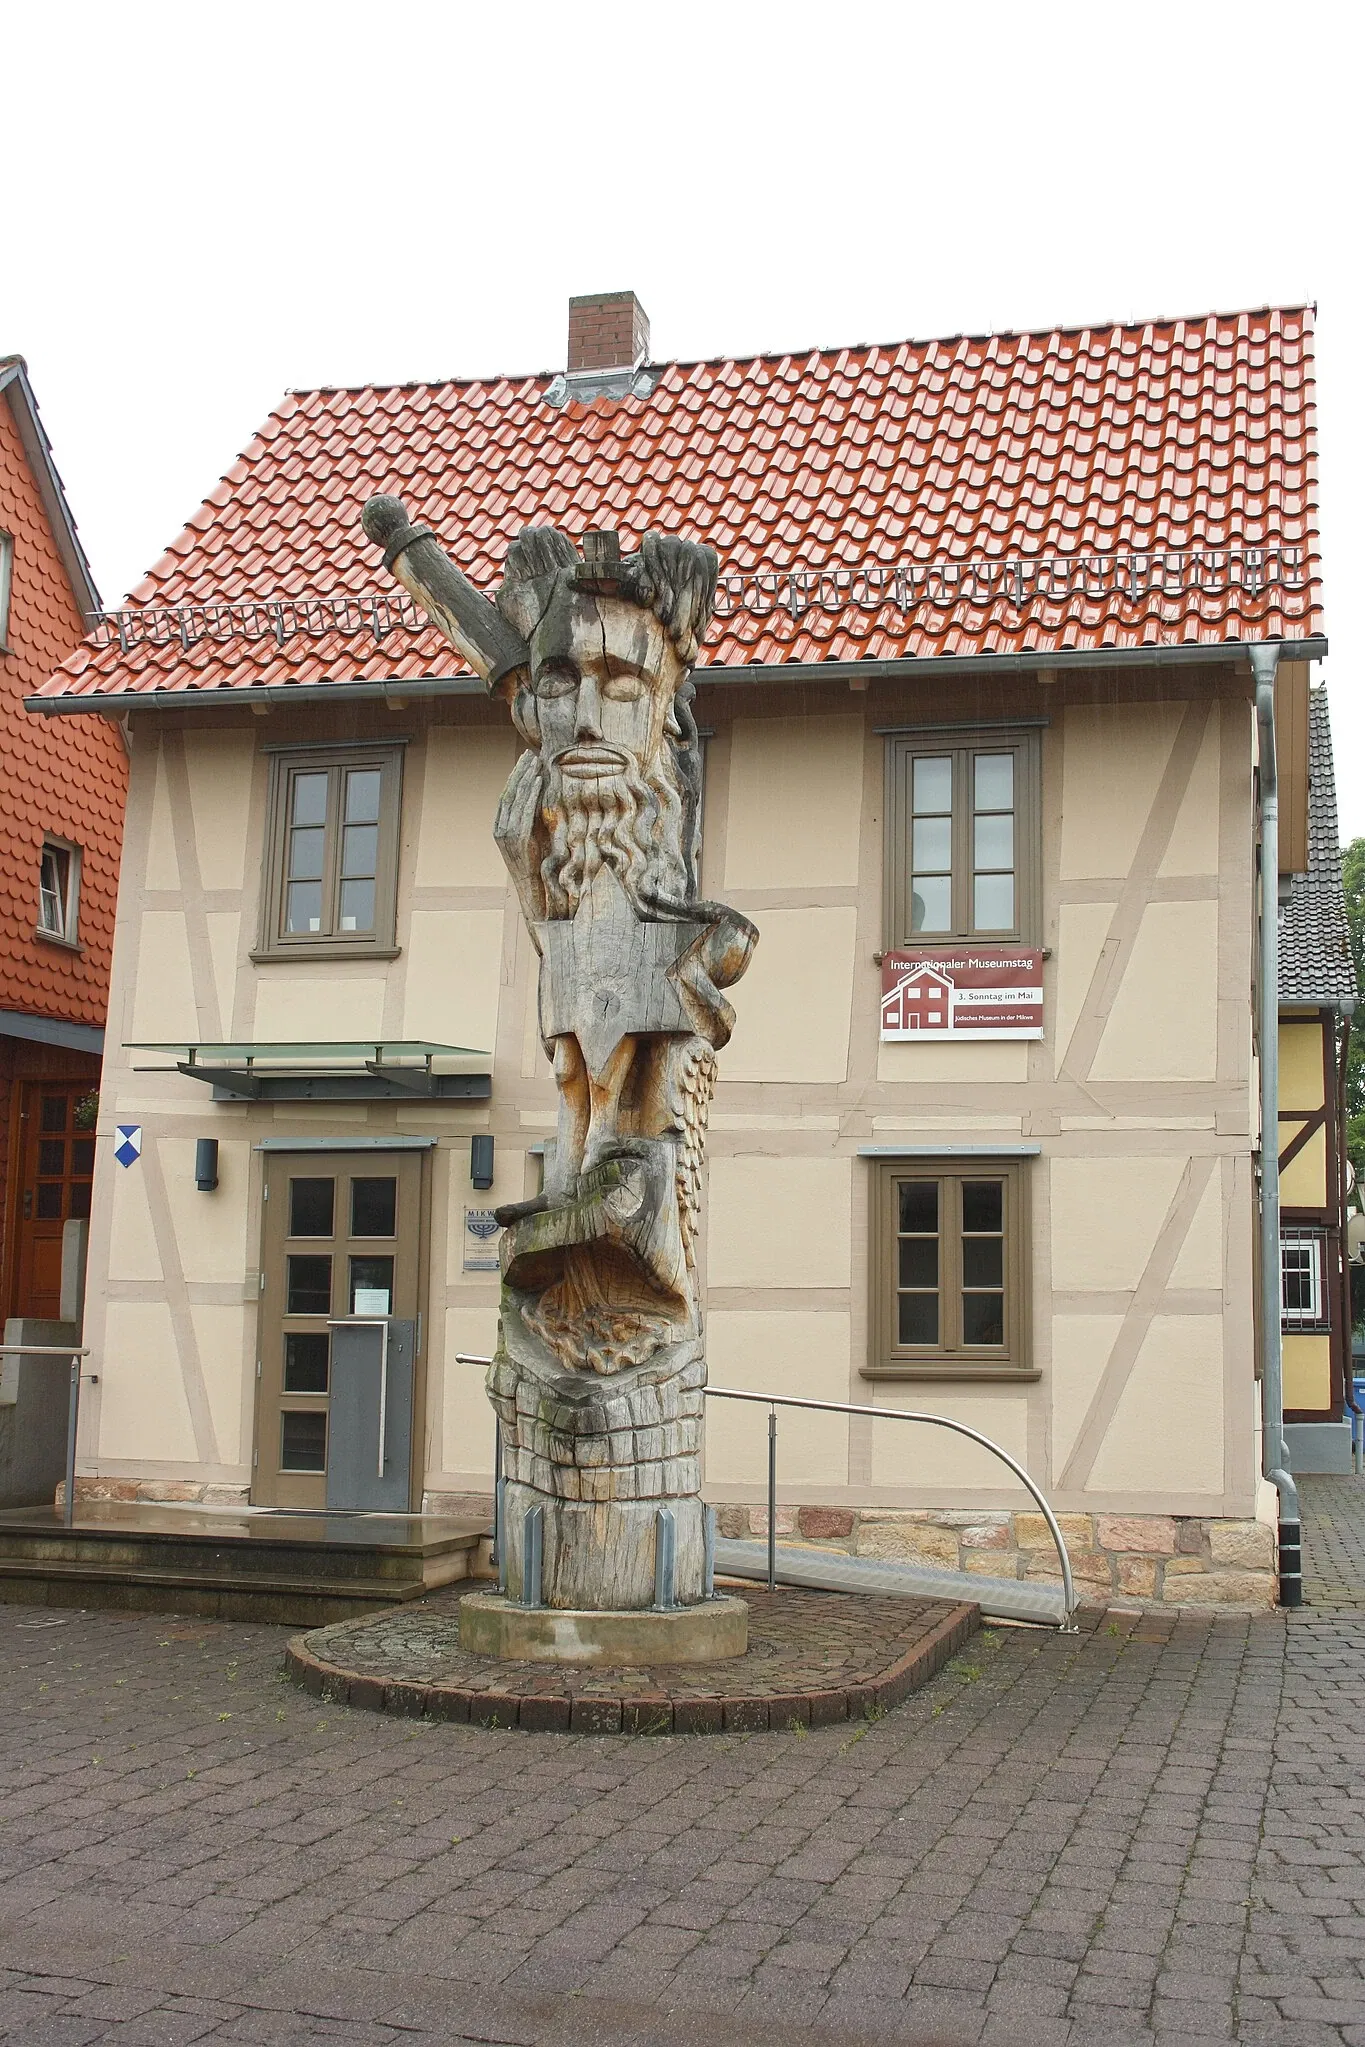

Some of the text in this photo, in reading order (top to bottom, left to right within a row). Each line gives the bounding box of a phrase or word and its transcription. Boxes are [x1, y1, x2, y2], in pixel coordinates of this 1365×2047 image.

[890, 958, 1033, 970] Internationaler Museumstag
[968, 992, 1003, 1001] Sonntag
[1004, 992, 1016, 1000] im
[1017, 991, 1033, 999] Mai
